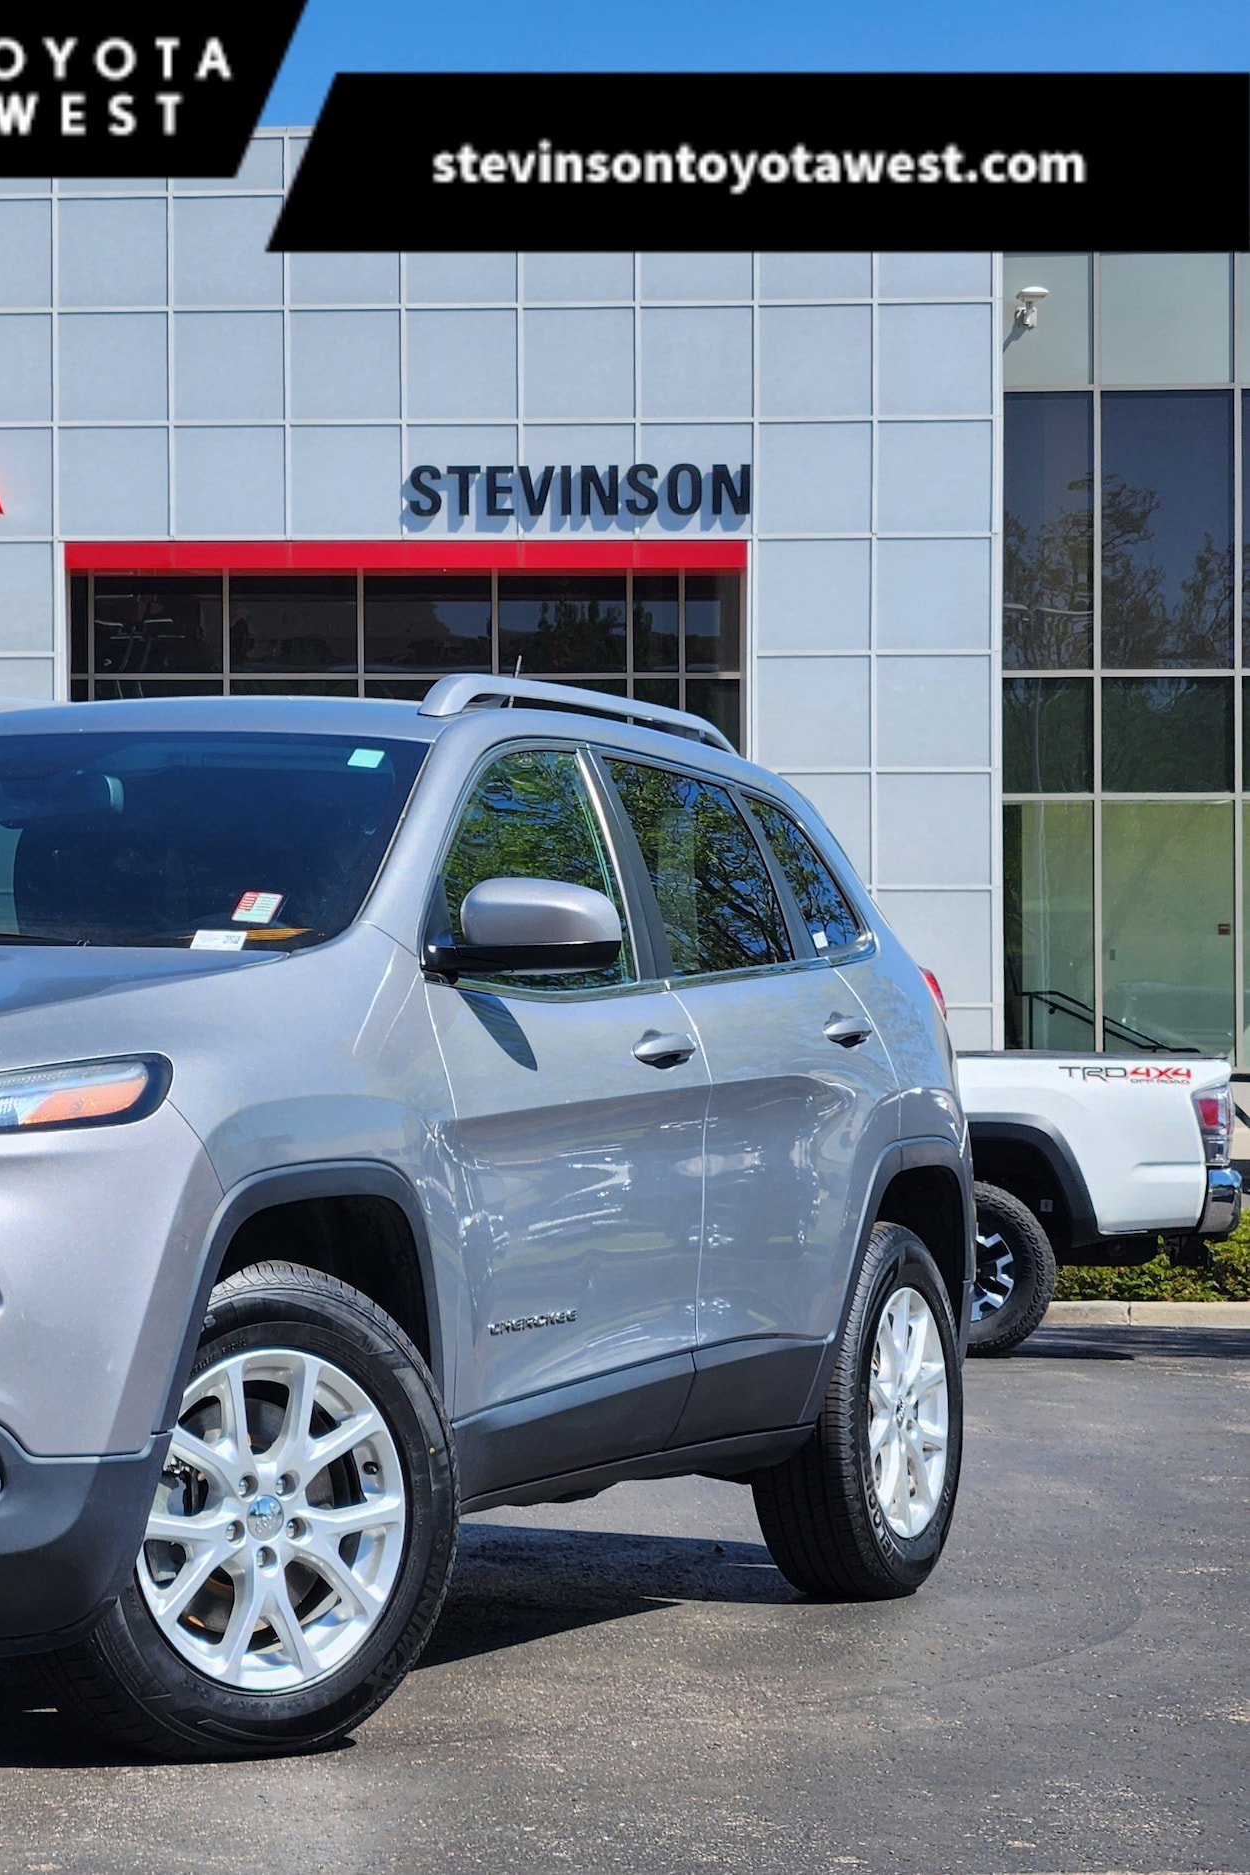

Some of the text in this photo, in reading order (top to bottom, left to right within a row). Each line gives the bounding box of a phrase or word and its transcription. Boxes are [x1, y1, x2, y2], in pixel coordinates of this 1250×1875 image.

[409, 463, 752, 517] STEVINSON
[1059, 1066, 1127, 1083] TRD
[487, 1308, 578, 1336] CHEROKEE
